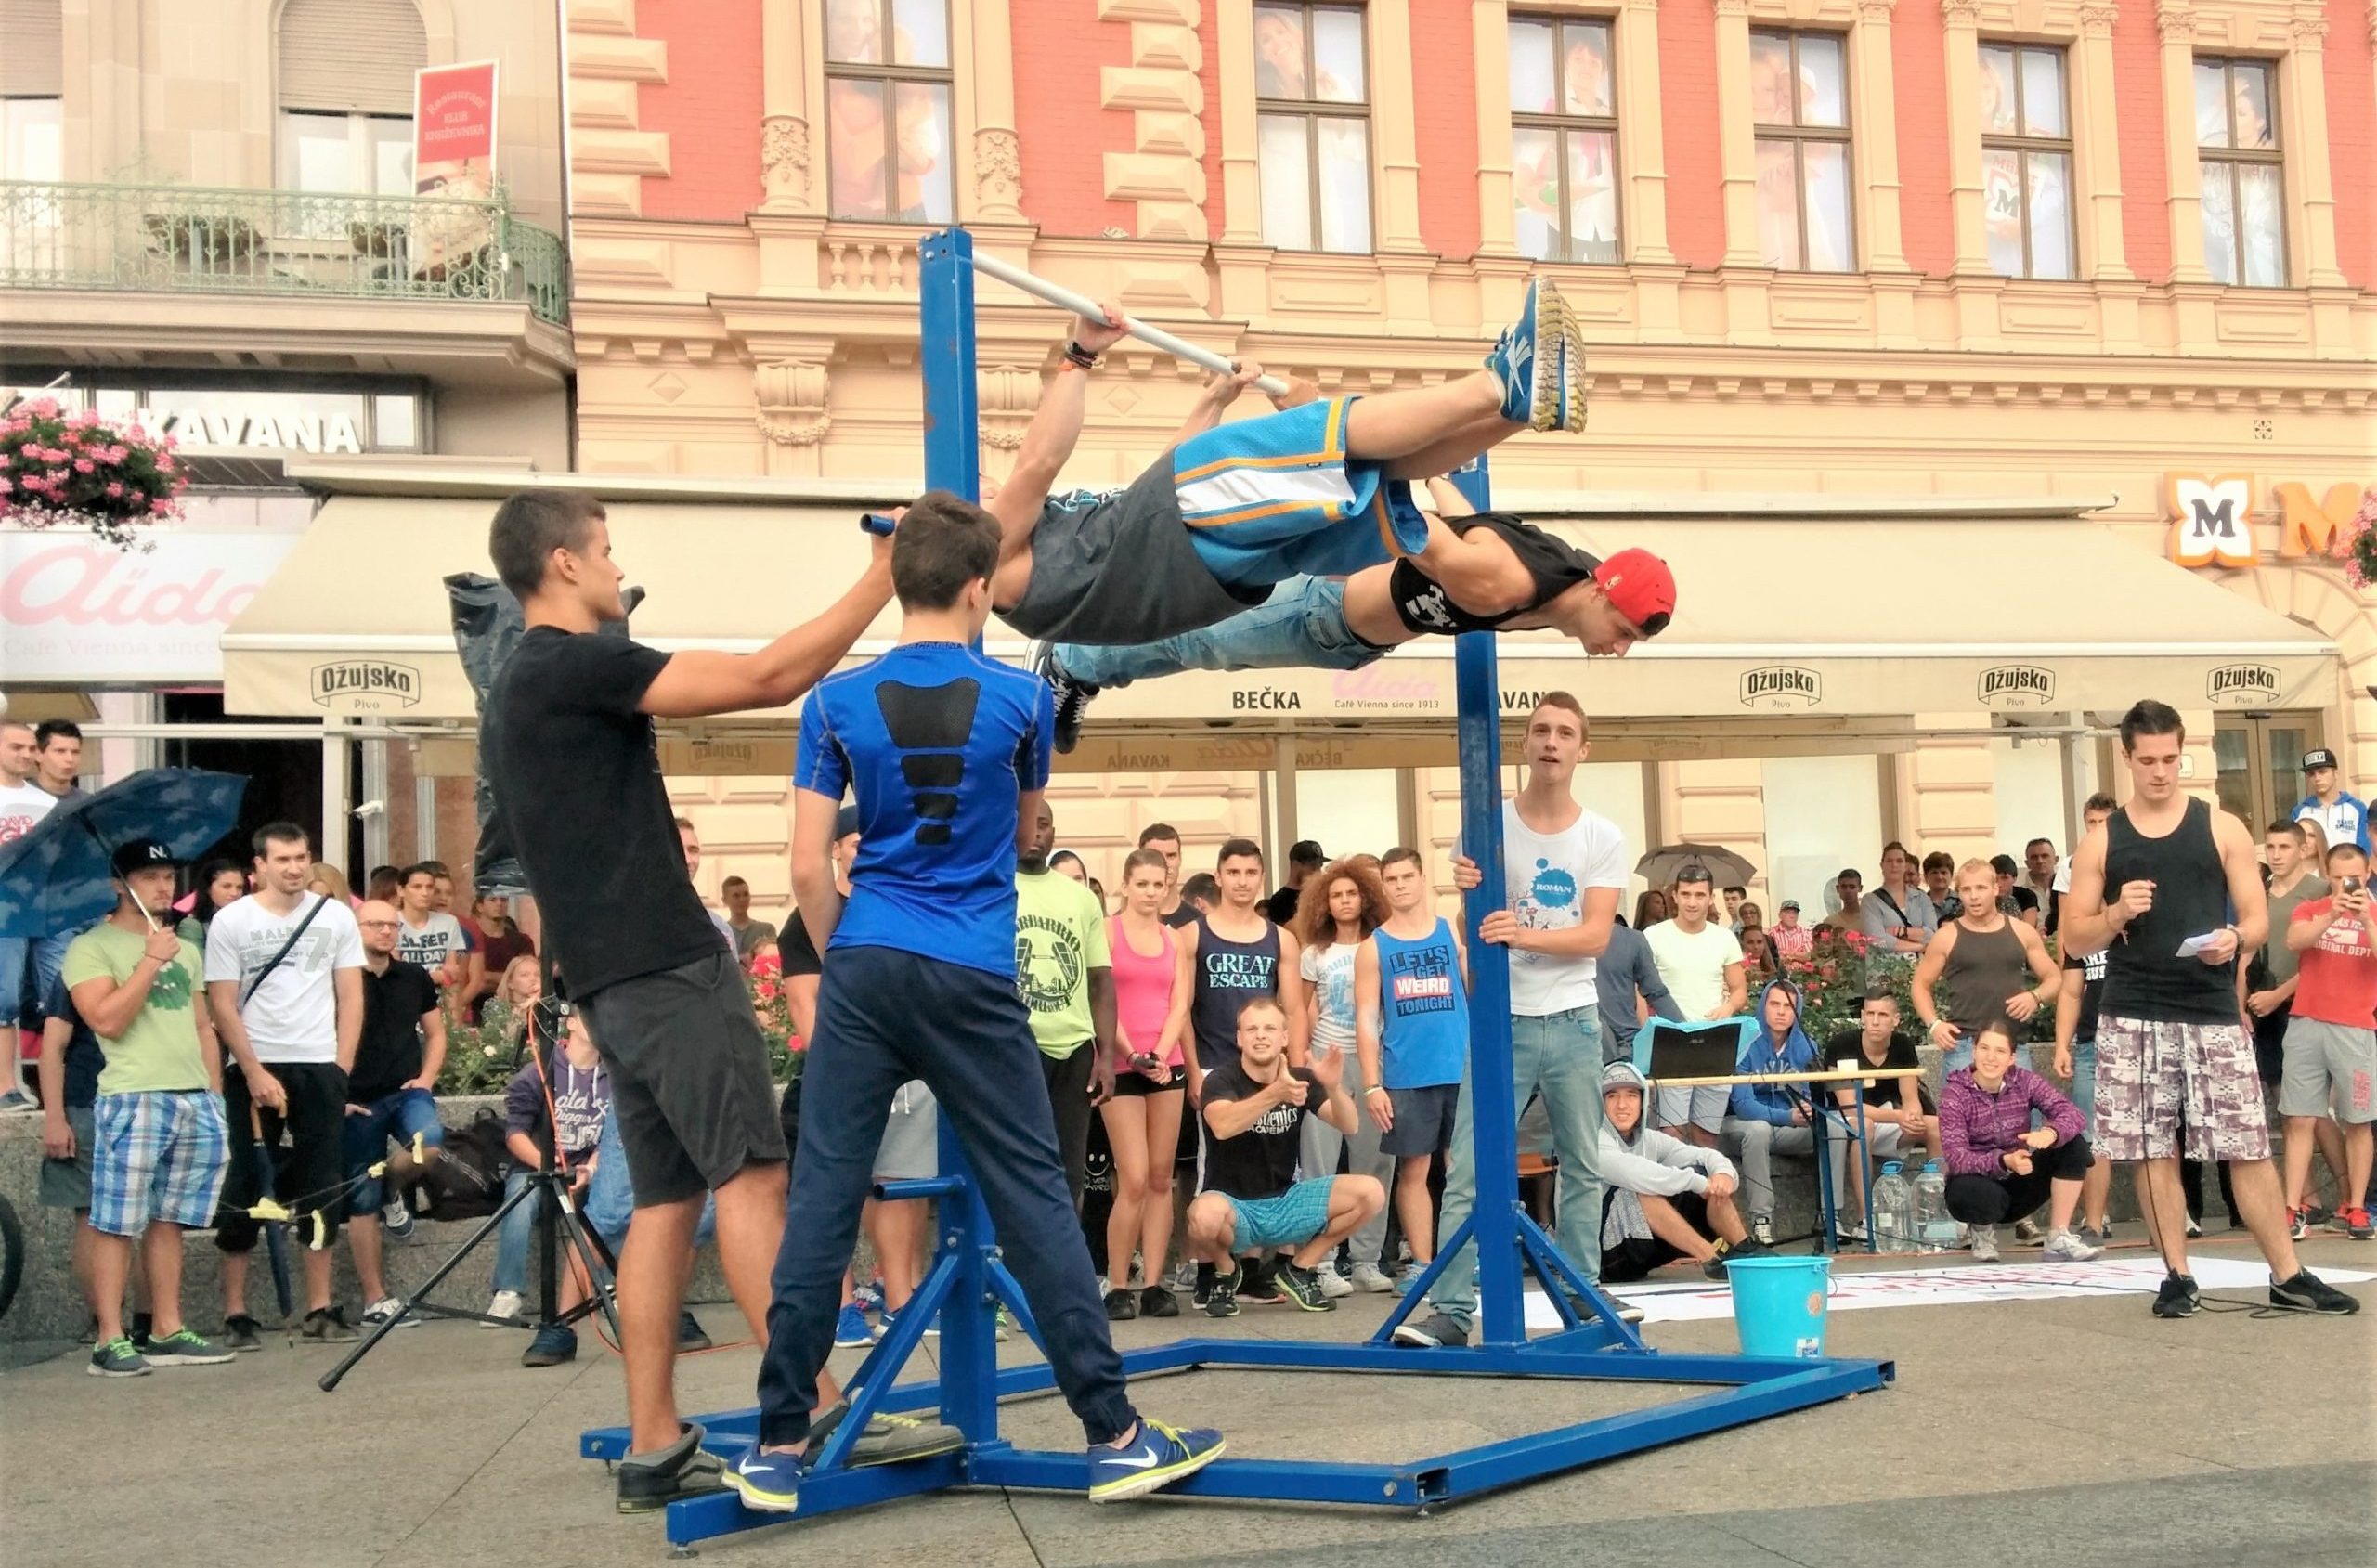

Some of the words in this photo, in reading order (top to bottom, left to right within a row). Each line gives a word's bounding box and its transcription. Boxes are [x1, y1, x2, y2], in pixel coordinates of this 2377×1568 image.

[138, 408, 361, 454] KAVANA
[2191, 499, 2236, 538] M
[321, 664, 410, 693] Ožujsko
[1747, 668, 1814, 694] Ožujsko
[1985, 667, 2047, 693] Ožujsko
[2214, 666, 2274, 691] Ožujsko
[354, 699, 380, 709] Pivo
[1232, 686, 1302, 709] BEČKA
[1357, 700, 1388, 708] Vienna
[1391, 700, 1414, 708] since
[1418, 700, 1439, 709] 1913
[1499, 691, 1545, 709] VAN
[1772, 699, 1791, 708] Pivo
[2007, 697, 2025, 706] Pivo
[2234, 695, 2253, 704] Pivo
[1536, 883, 1572, 893] ROMAN
[401, 952, 422, 963] ALL
[1392, 948, 1448, 971] LET'S
[2347, 945, 2371, 957] DEPT
[1206, 953, 1276, 975] GREAT
[1416, 963, 1445, 978] GET
[1209, 974, 1268, 989] ESCAPE
[1396, 978, 1449, 995] WEIRD
[1397, 996, 1454, 1015] TONIGHT
